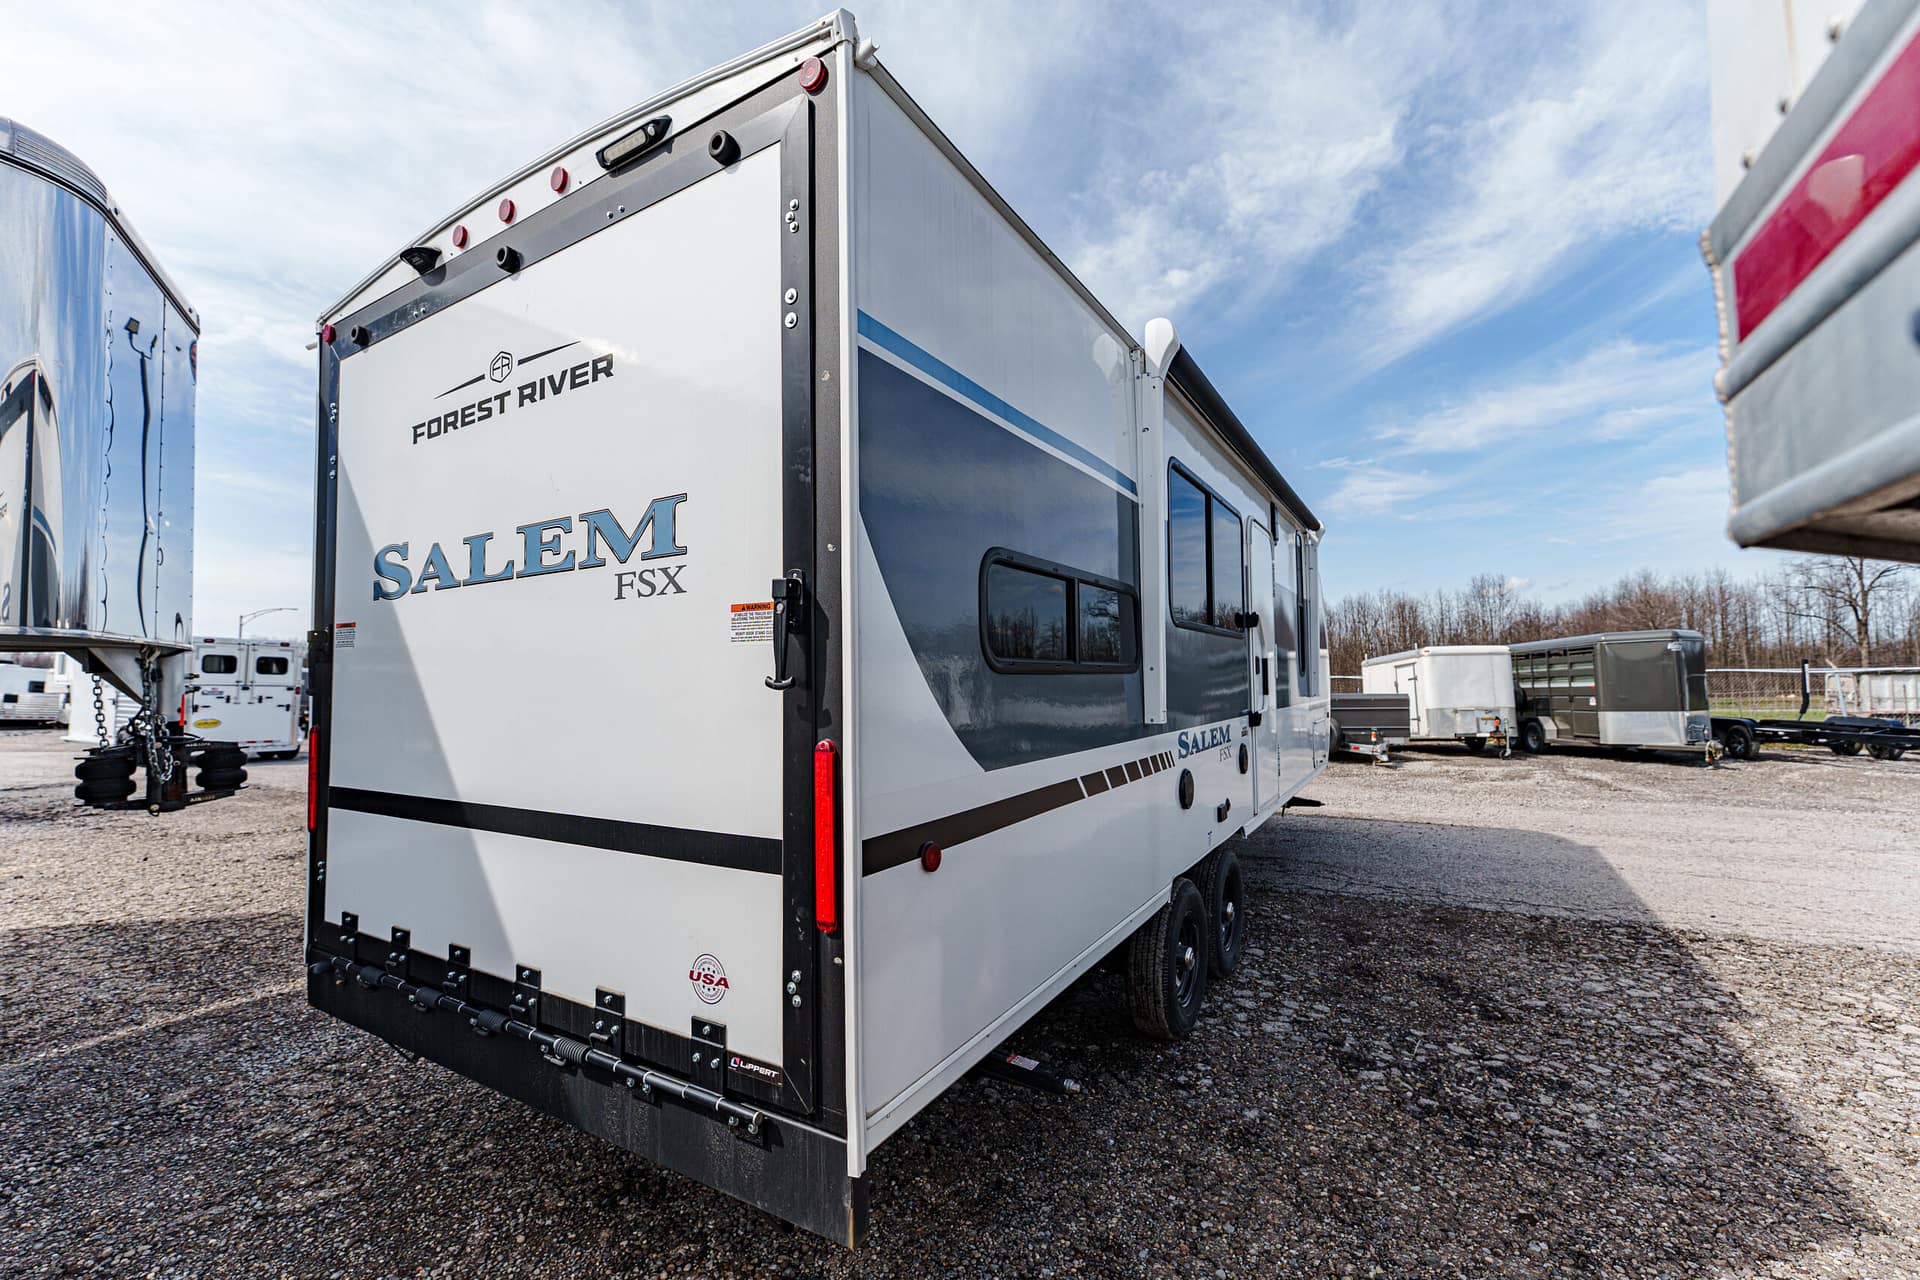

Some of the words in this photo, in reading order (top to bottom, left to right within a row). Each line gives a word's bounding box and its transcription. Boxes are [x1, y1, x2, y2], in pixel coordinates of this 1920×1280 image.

[412, 390, 511, 445] FOREST
[517, 353, 614, 408] RIVER
[373, 493, 688, 601] SALEM
[614, 565, 688, 600] FSX
[1178, 724, 1232, 760] SALEM
[689, 970, 730, 989] USA
